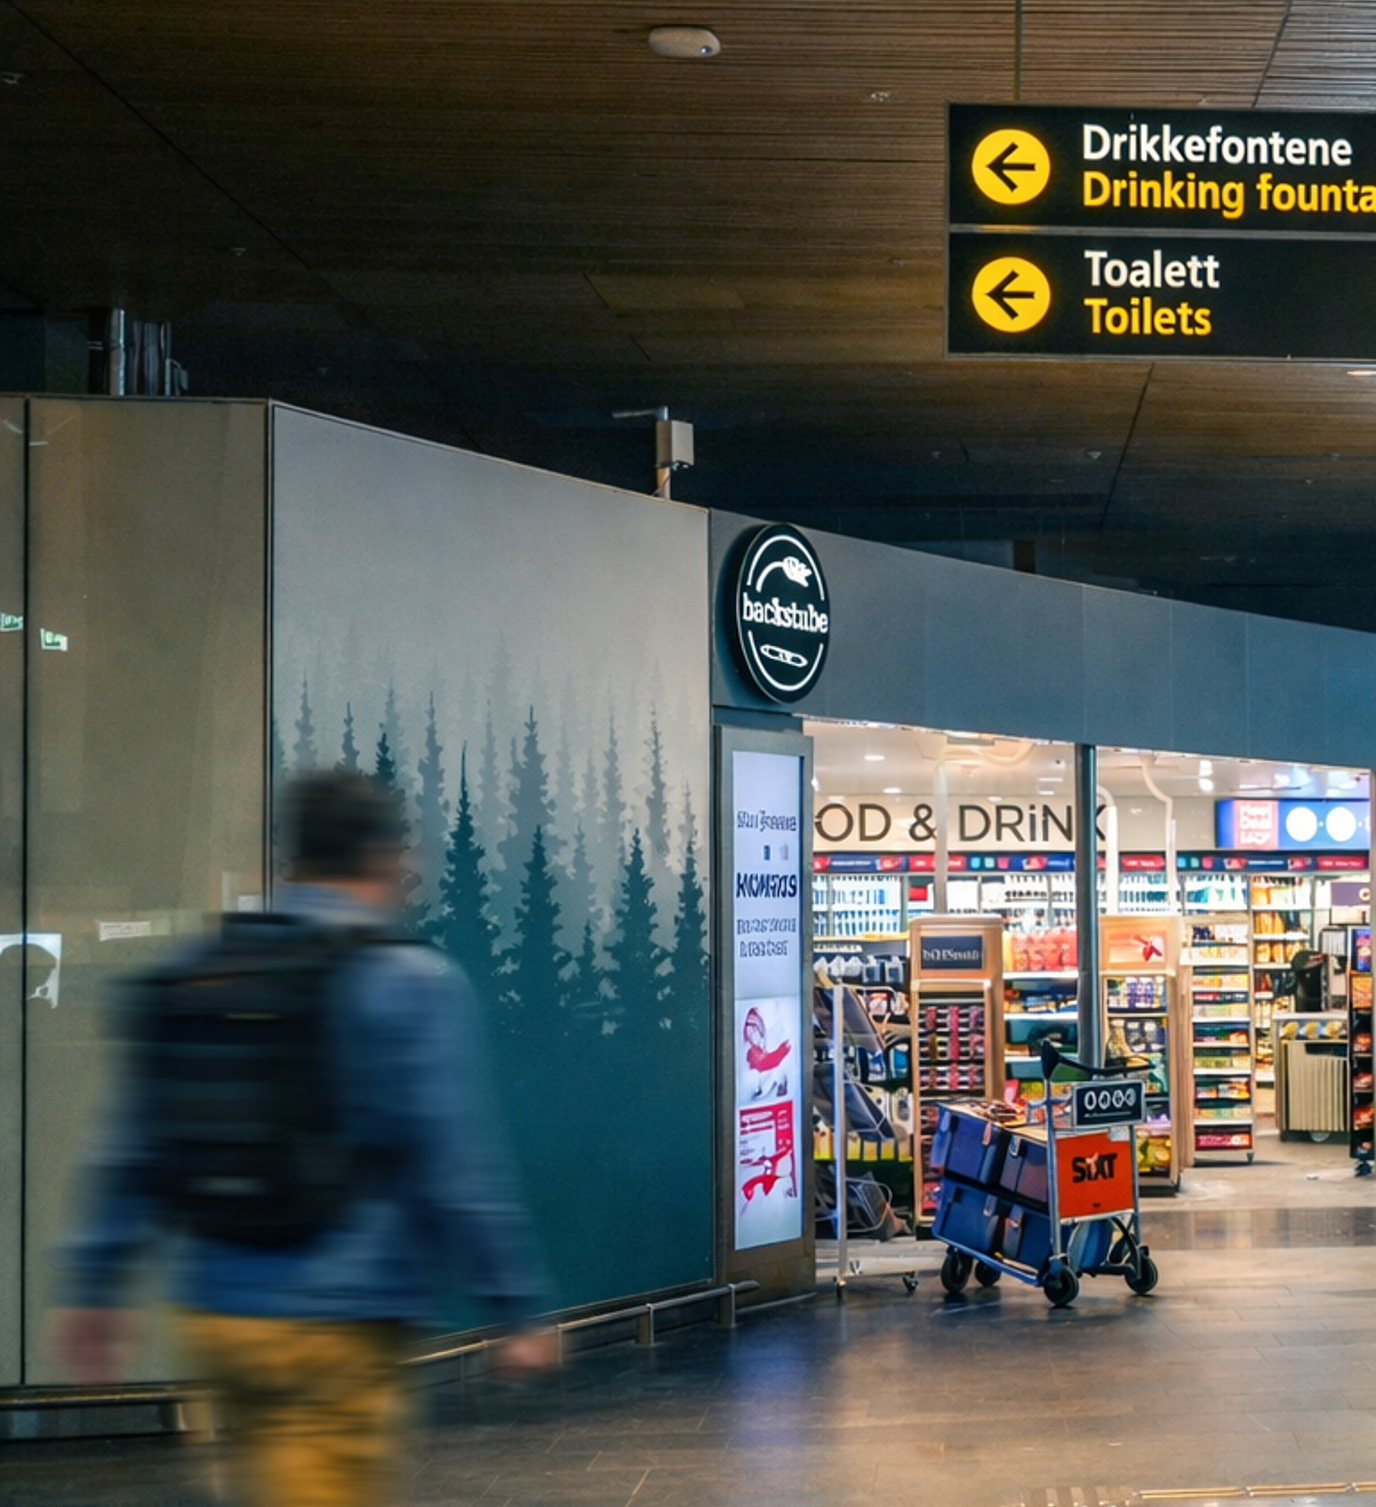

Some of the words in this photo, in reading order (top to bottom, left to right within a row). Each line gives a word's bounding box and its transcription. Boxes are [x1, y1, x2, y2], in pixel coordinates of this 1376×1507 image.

[1082, 123, 1353, 166] Drikkefontene
[1082, 171, 1245, 219] Drinking
[1083, 249, 1220, 290] Toalett
[1083, 296, 1212, 337] Toilets
[743, 592, 829, 633] backstube
[908, 803, 937, 842] &
